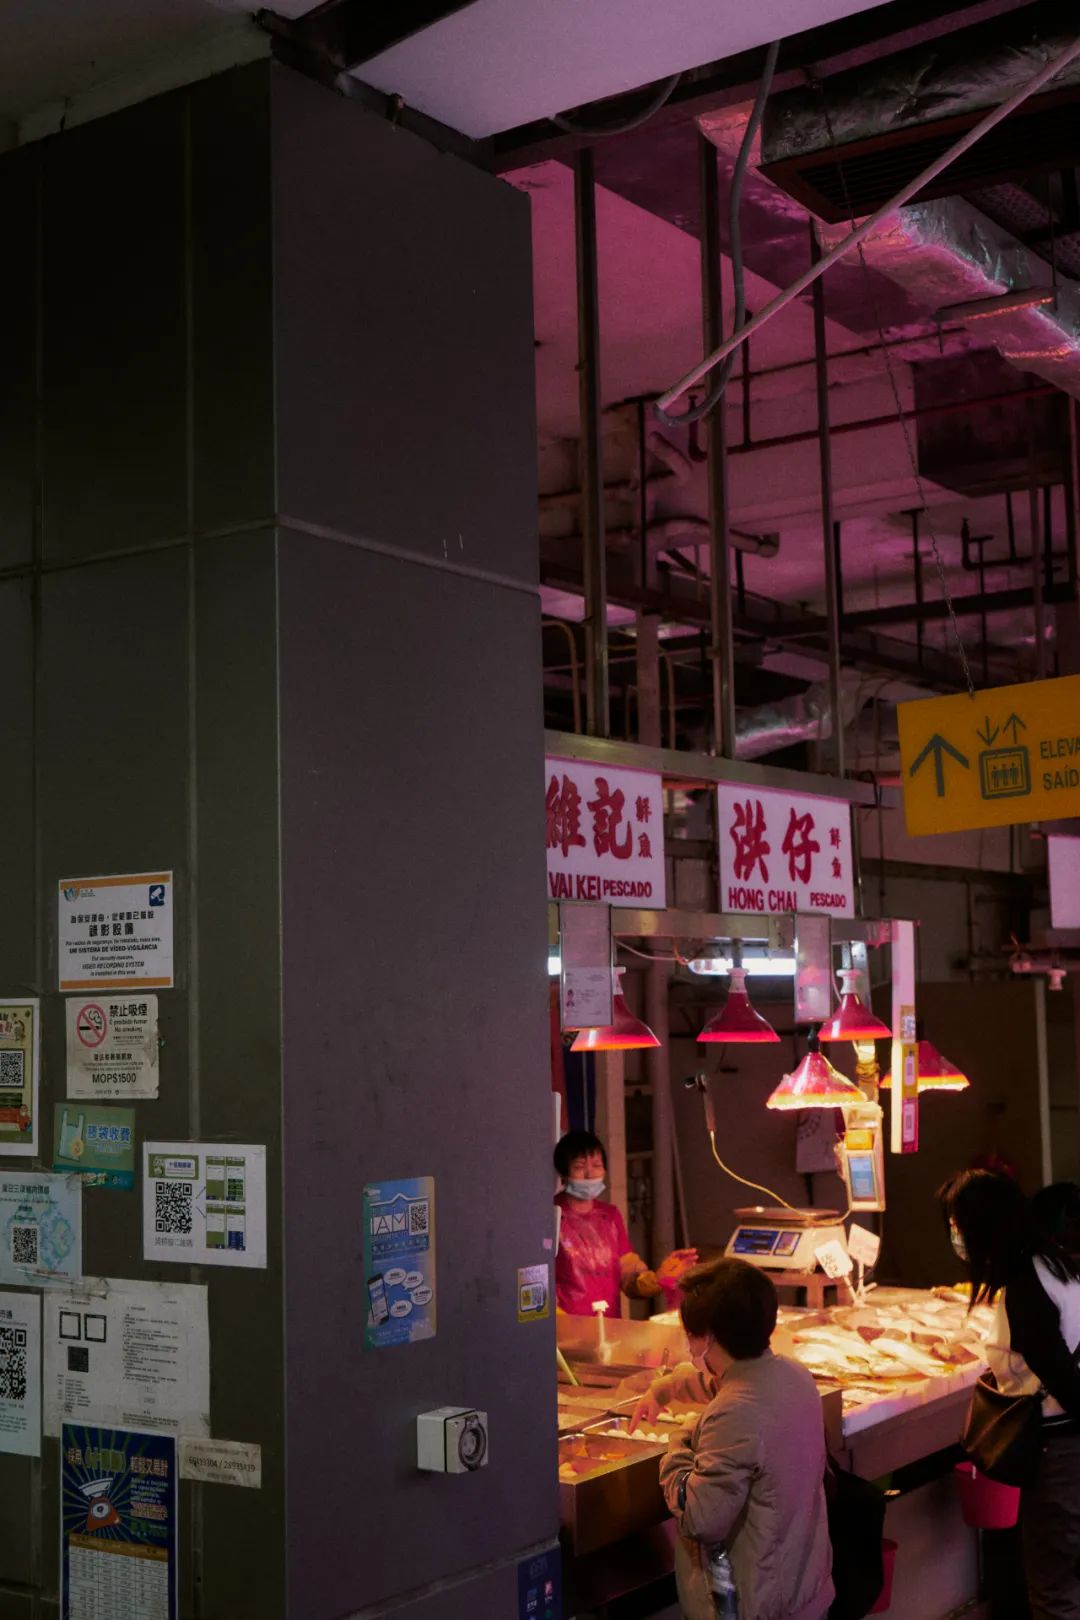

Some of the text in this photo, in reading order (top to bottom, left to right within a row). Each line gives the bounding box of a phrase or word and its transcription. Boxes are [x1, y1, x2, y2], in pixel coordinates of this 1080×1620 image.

[729, 799, 821, 884] 洪仔
[576, 874, 602, 900] KEI
[603, 879, 652, 898] PESCADO
[728, 887, 846, 912] HONG CHAI PESCADO
[110, 1003, 148, 1017] 禁止吸煙
